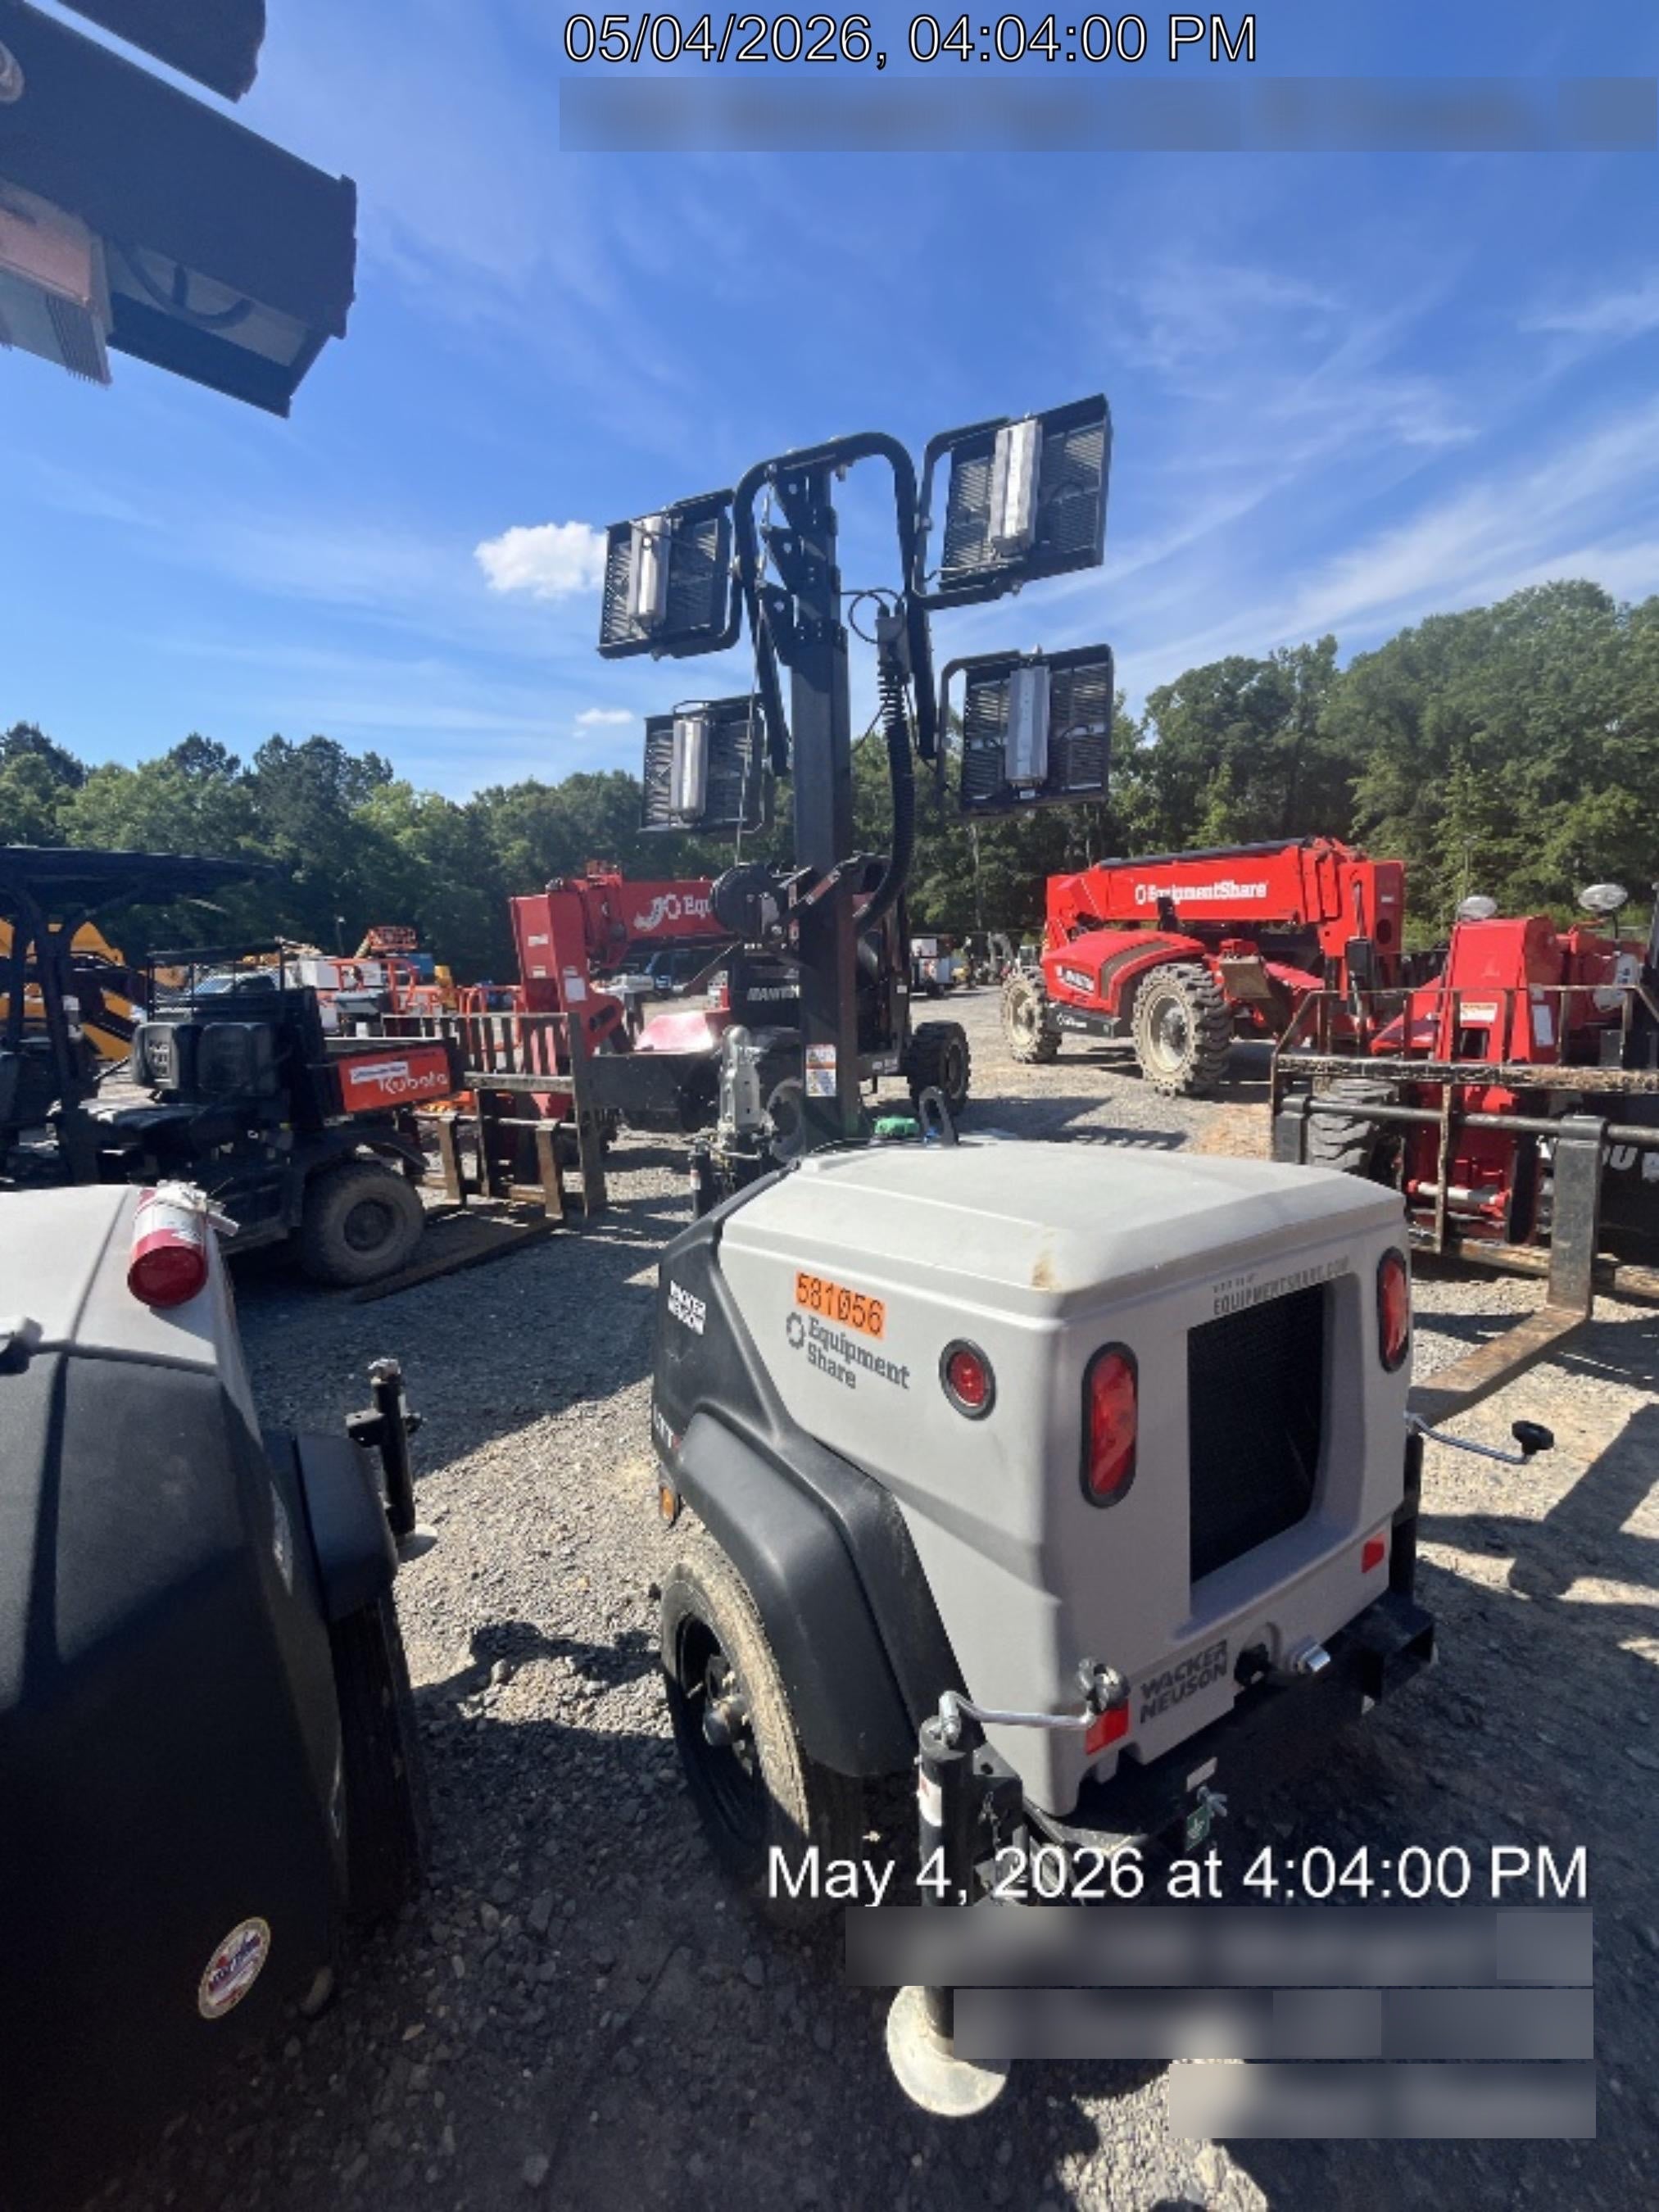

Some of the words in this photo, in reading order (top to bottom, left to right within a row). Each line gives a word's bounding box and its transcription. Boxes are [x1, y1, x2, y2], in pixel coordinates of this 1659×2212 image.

[378, 1071, 448, 1095] Kubota
[797, 1272, 884, 1335] 581056
[808, 1315, 911, 1389] Equipment
[808, 1342, 856, 1389] Share
[1140, 1639, 1227, 1701] WACKER
[1140, 1664, 1227, 1724] NEUSON
